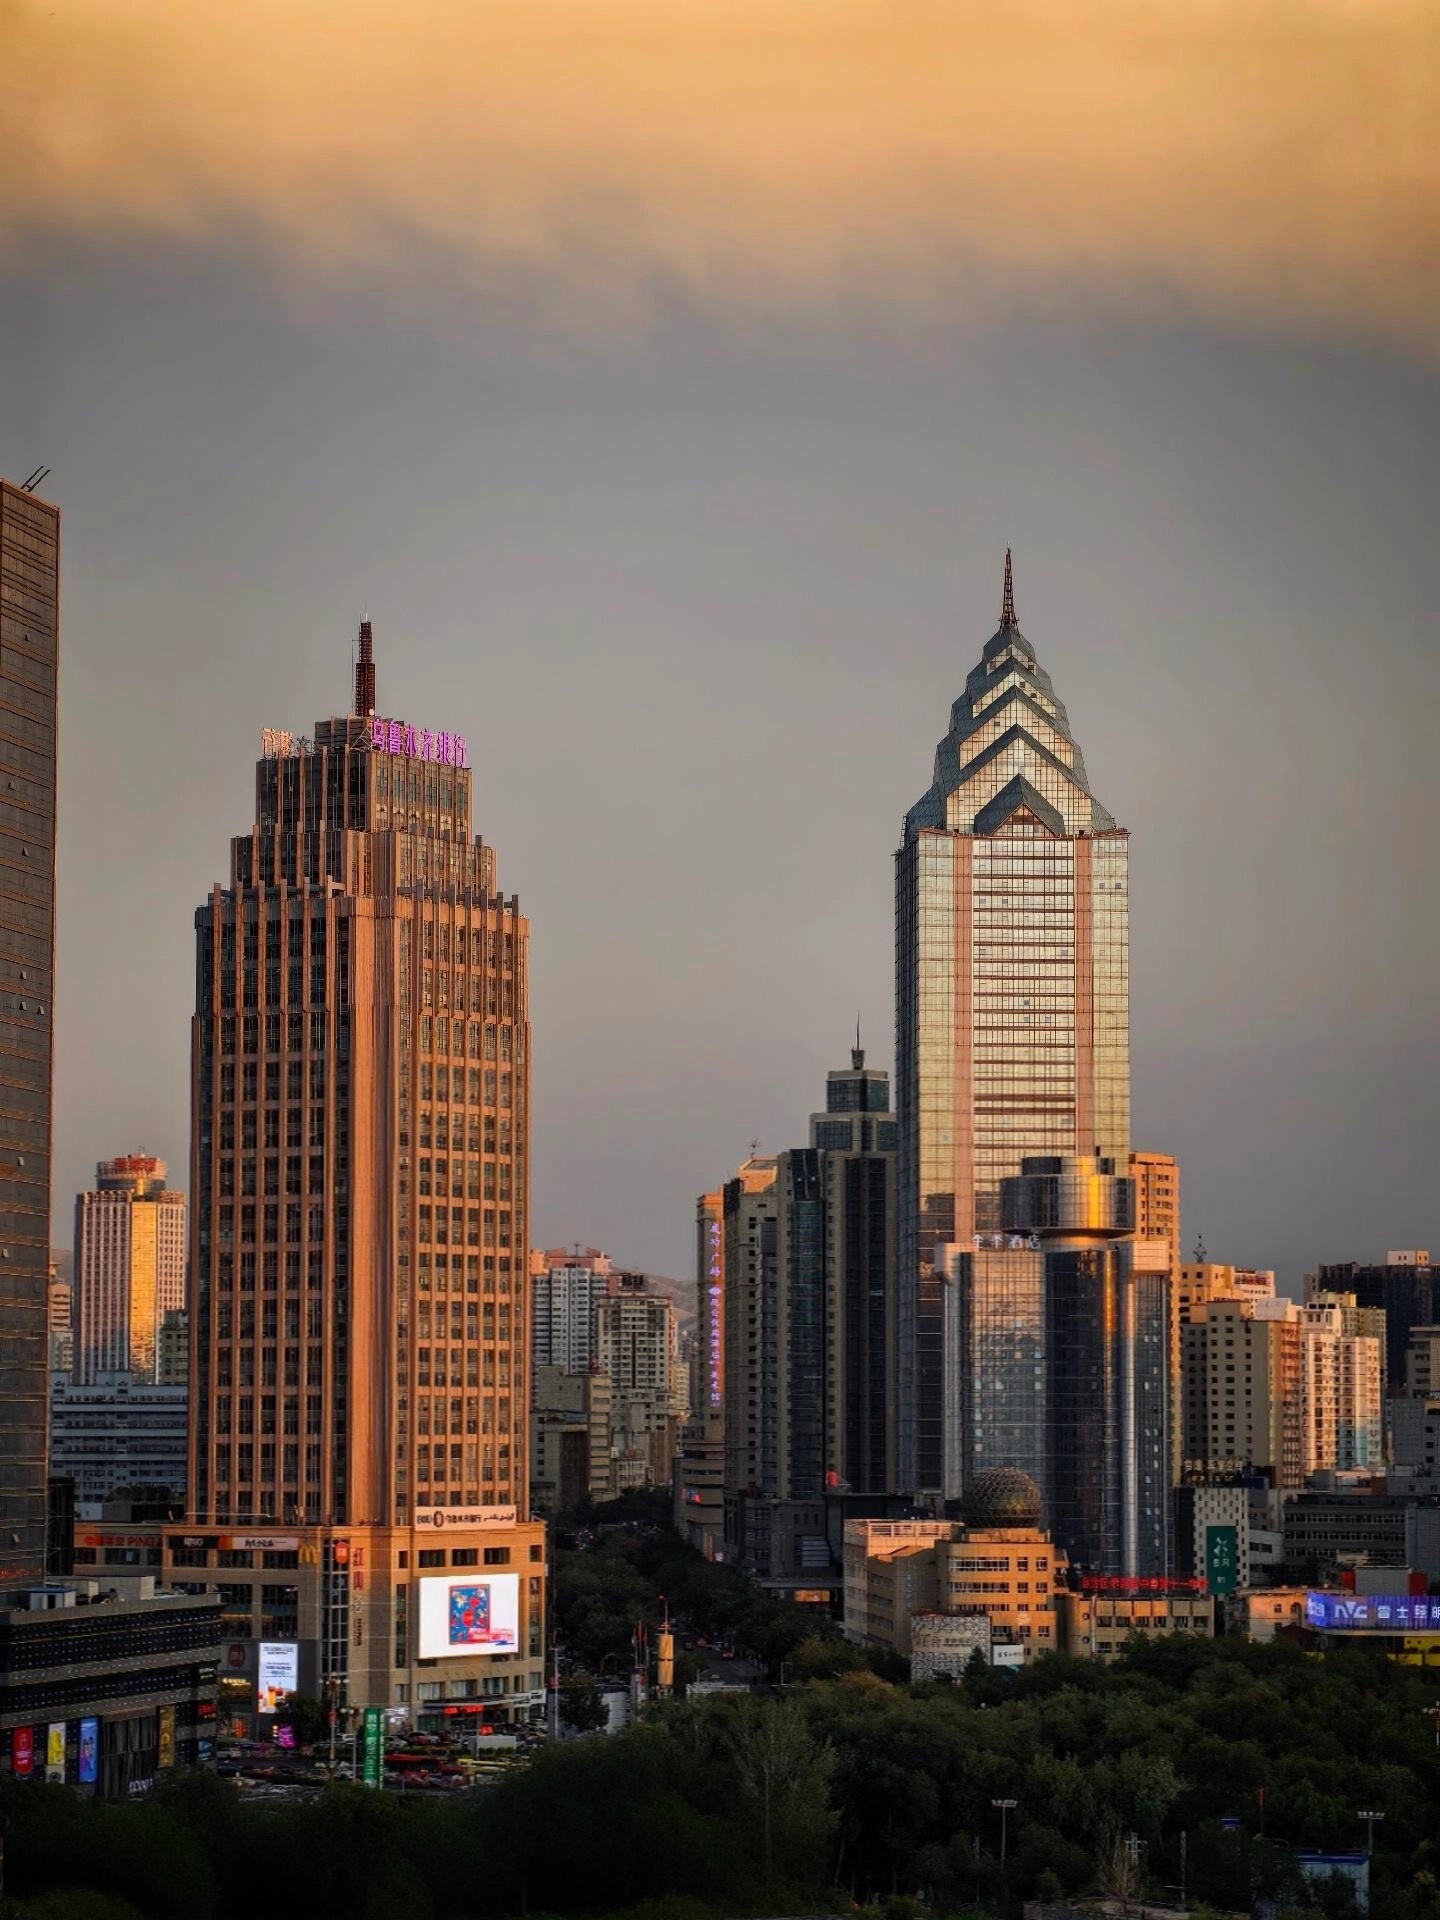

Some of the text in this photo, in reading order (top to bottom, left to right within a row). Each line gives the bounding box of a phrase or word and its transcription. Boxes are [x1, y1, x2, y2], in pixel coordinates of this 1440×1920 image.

[372, 718, 467, 768] 乌鲁木齐银行
